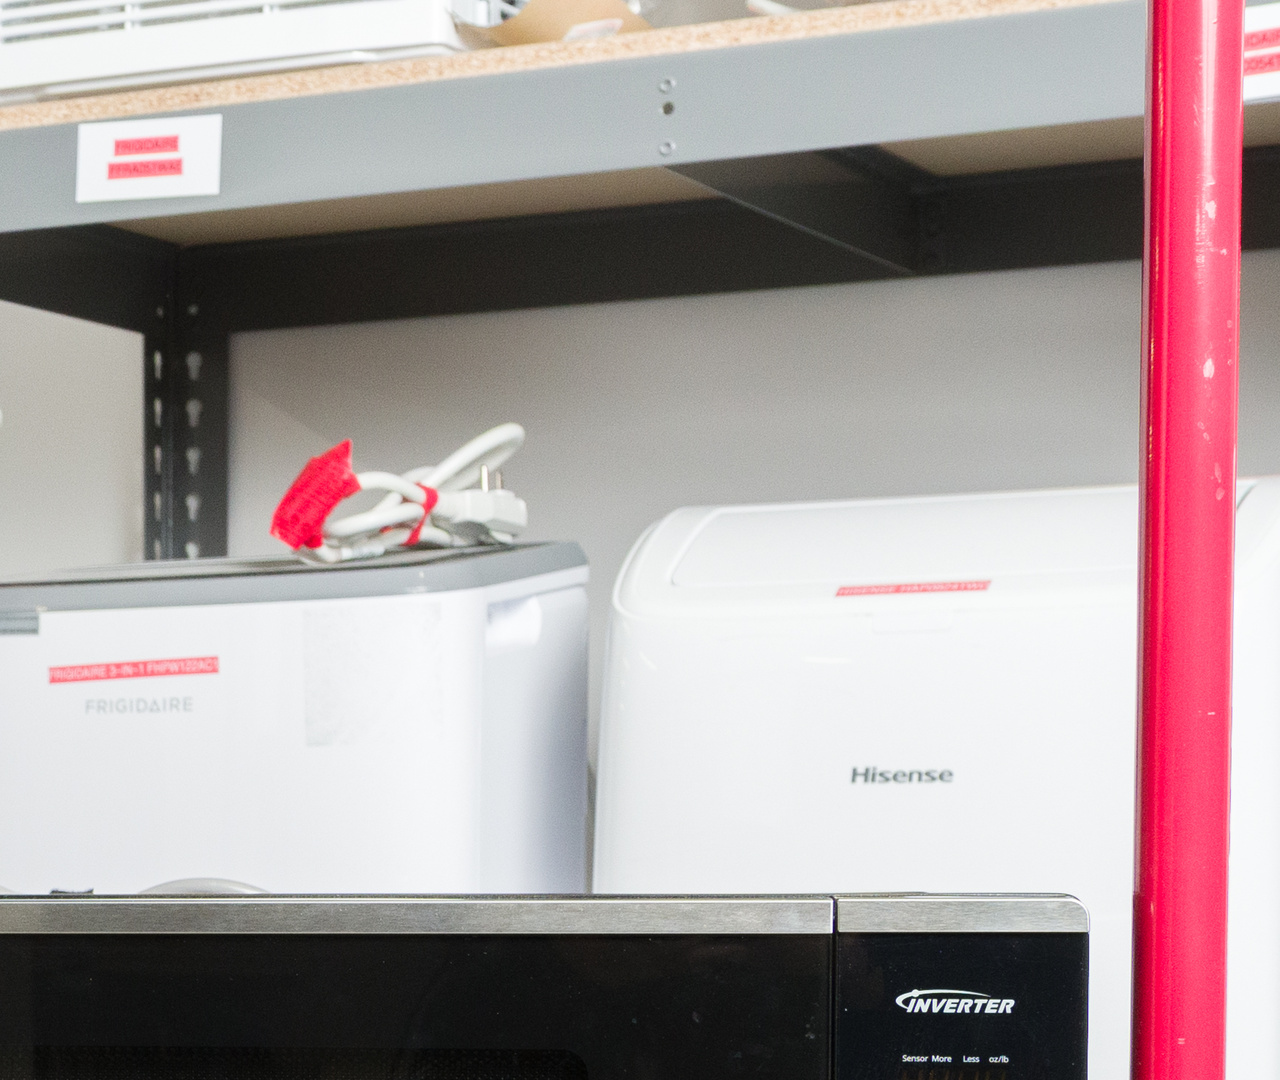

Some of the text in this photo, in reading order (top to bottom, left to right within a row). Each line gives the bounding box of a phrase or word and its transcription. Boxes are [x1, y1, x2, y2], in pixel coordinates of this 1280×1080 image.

[85, 696, 194, 714] FRIGIDAIRE
[851, 766, 954, 784] Hisense
[904, 990, 1016, 1014] INVERTER
[902, 1054, 1010, 1064] Sensor More Less oz/lb
